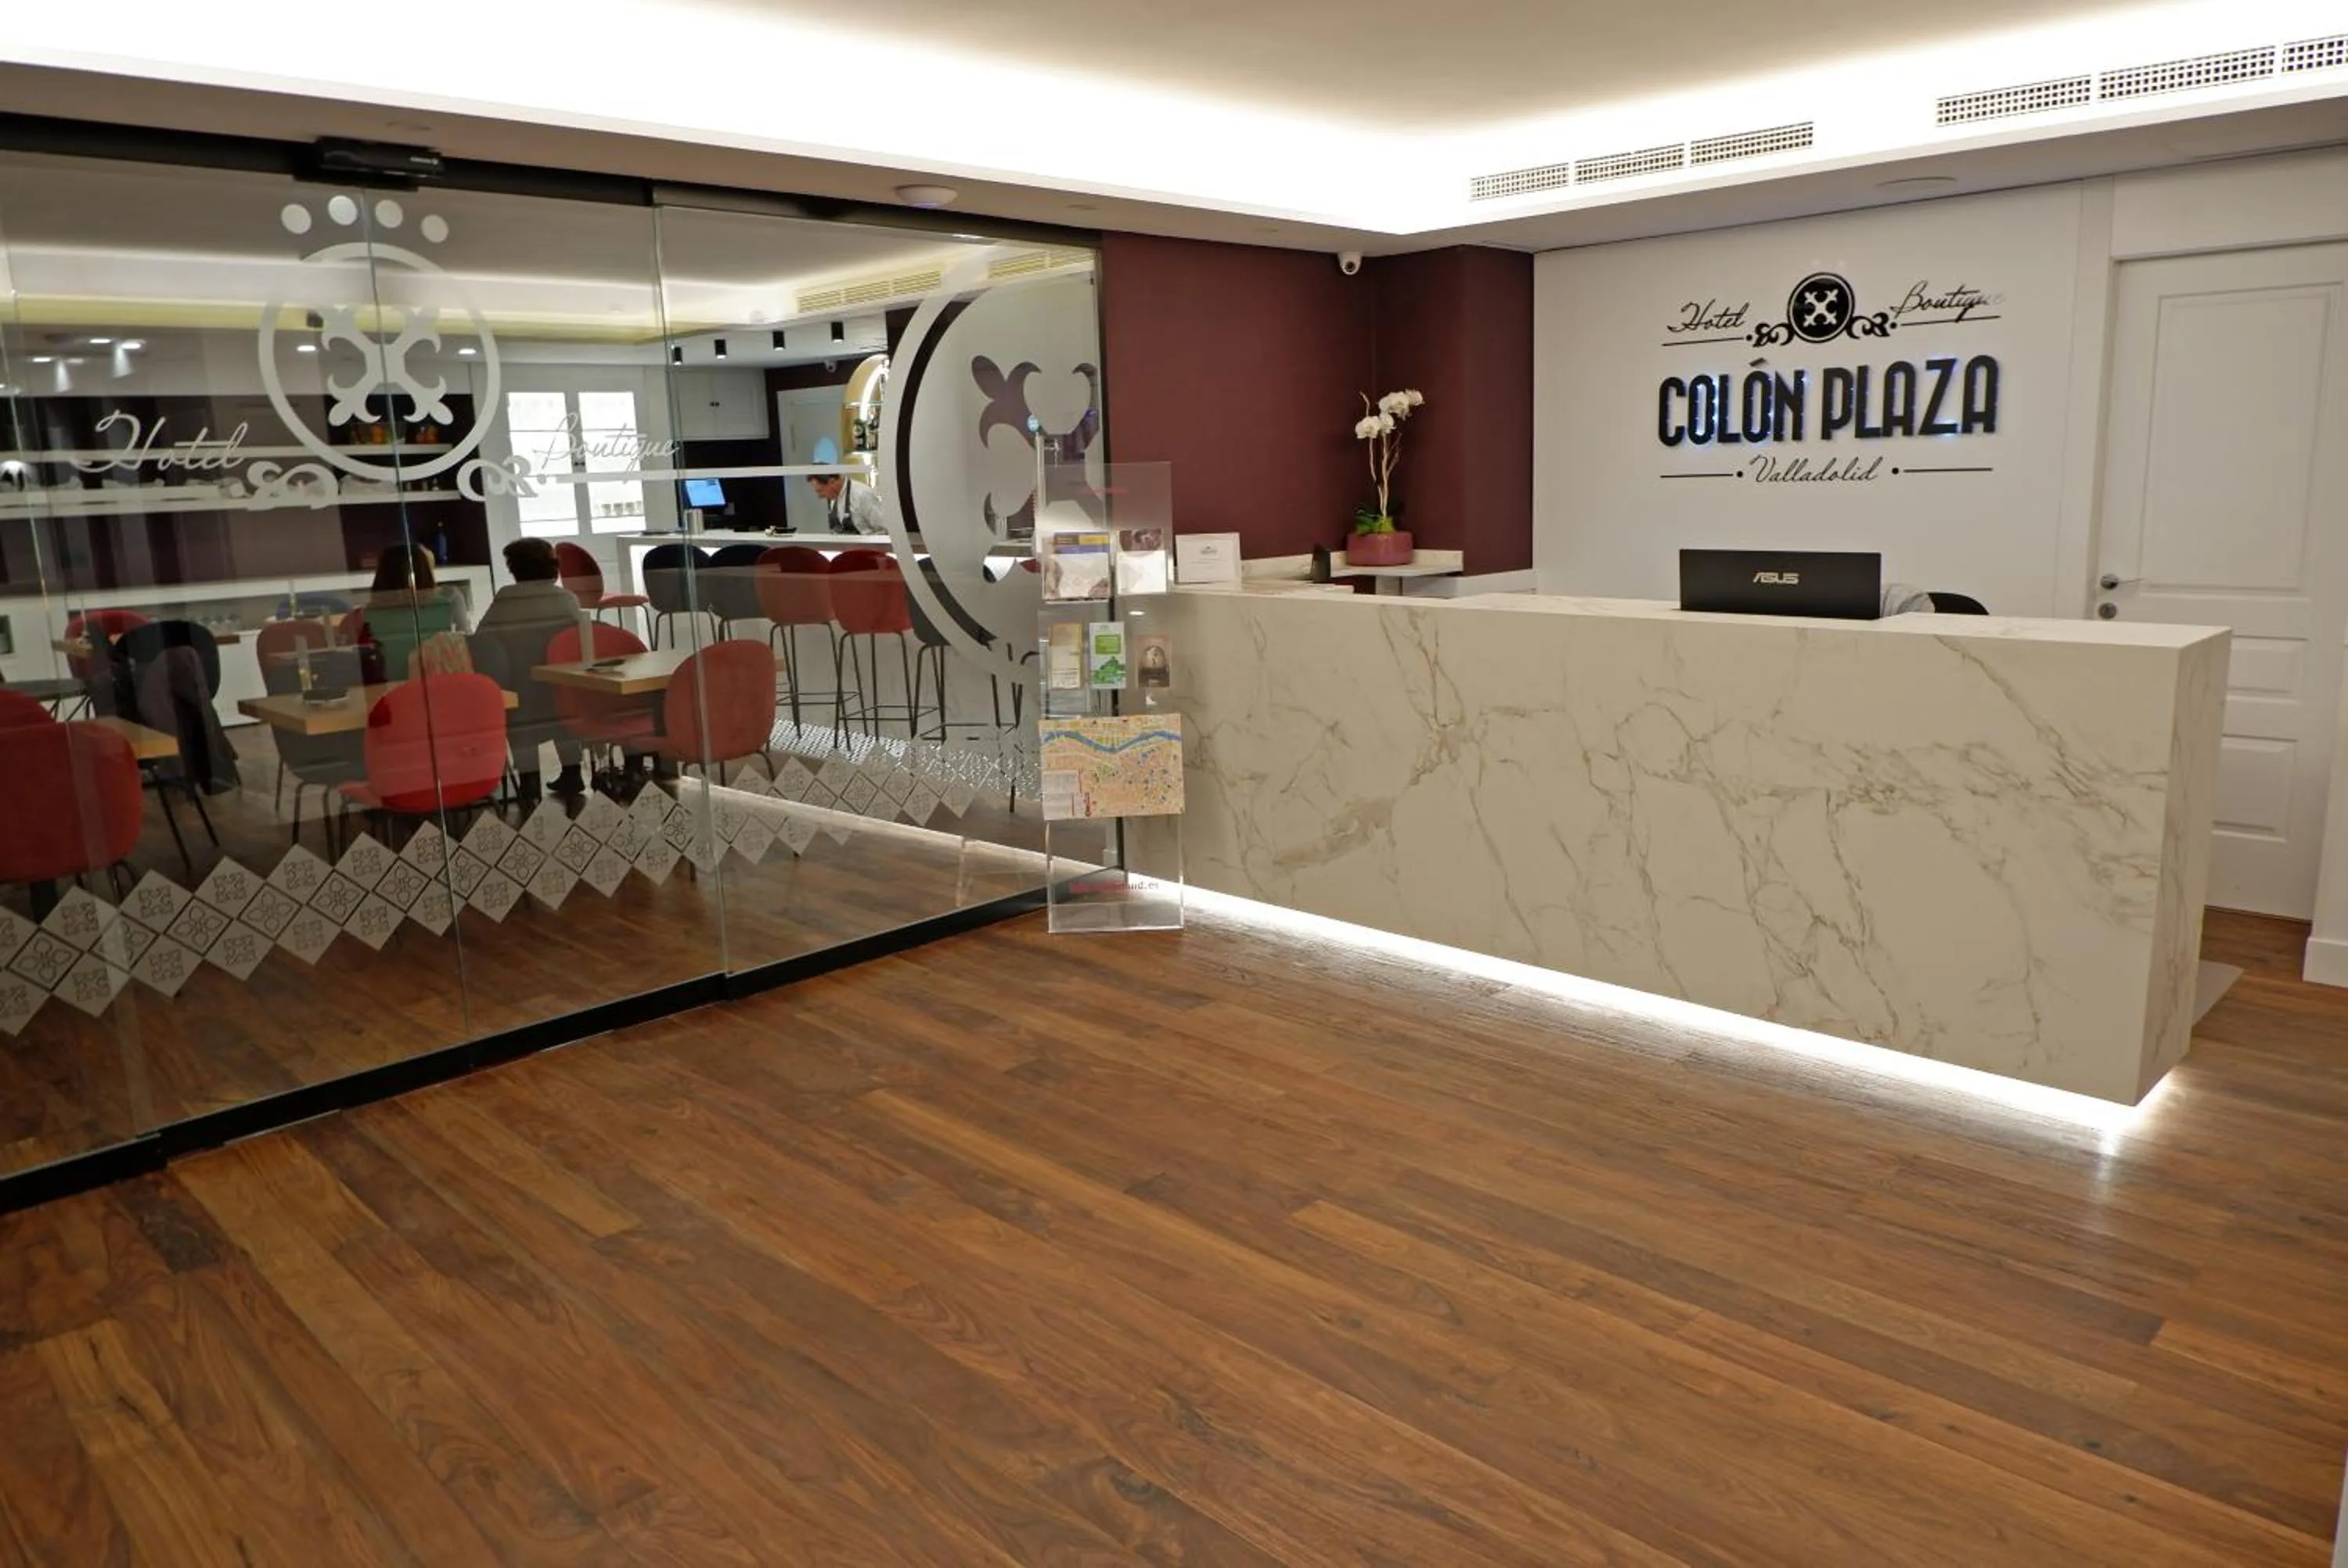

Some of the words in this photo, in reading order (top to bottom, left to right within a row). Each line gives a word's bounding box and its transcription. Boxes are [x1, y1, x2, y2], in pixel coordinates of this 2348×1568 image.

[1666, 299, 1750, 332] Hotel
[1658, 358, 1806, 447] COLÓN
[1820, 354, 2000, 441] PLAZA
[69, 409, 248, 473] Hotel
[533, 412, 679, 484] Boutique
[1748, 455, 1884, 483] Valladolid
[1752, 571, 1799, 585] ASUS
